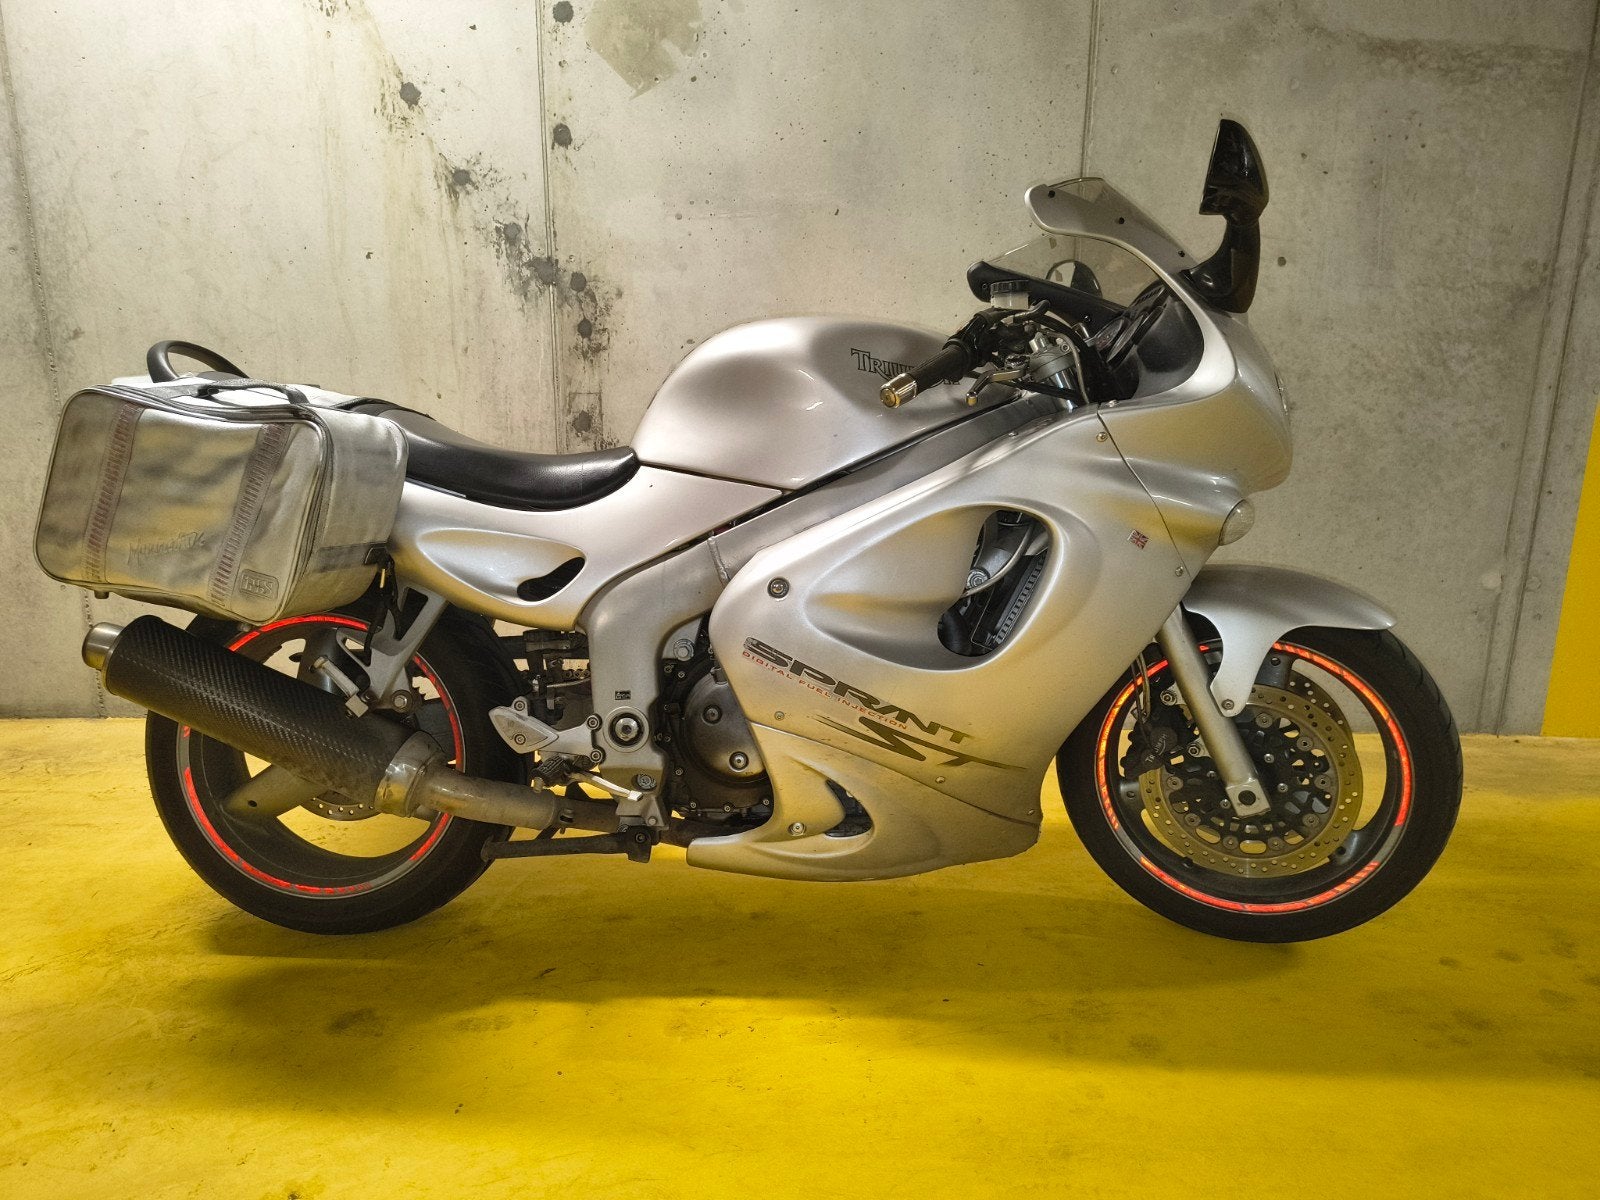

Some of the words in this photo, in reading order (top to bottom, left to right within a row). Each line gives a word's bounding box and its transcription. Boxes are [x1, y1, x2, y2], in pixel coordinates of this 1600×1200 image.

[742, 650, 793, 680] DIGITAL
[798, 679, 831, 698] FUEL
[837, 697, 908, 730] INJECTION
[743, 636, 976, 744] SPRINT
